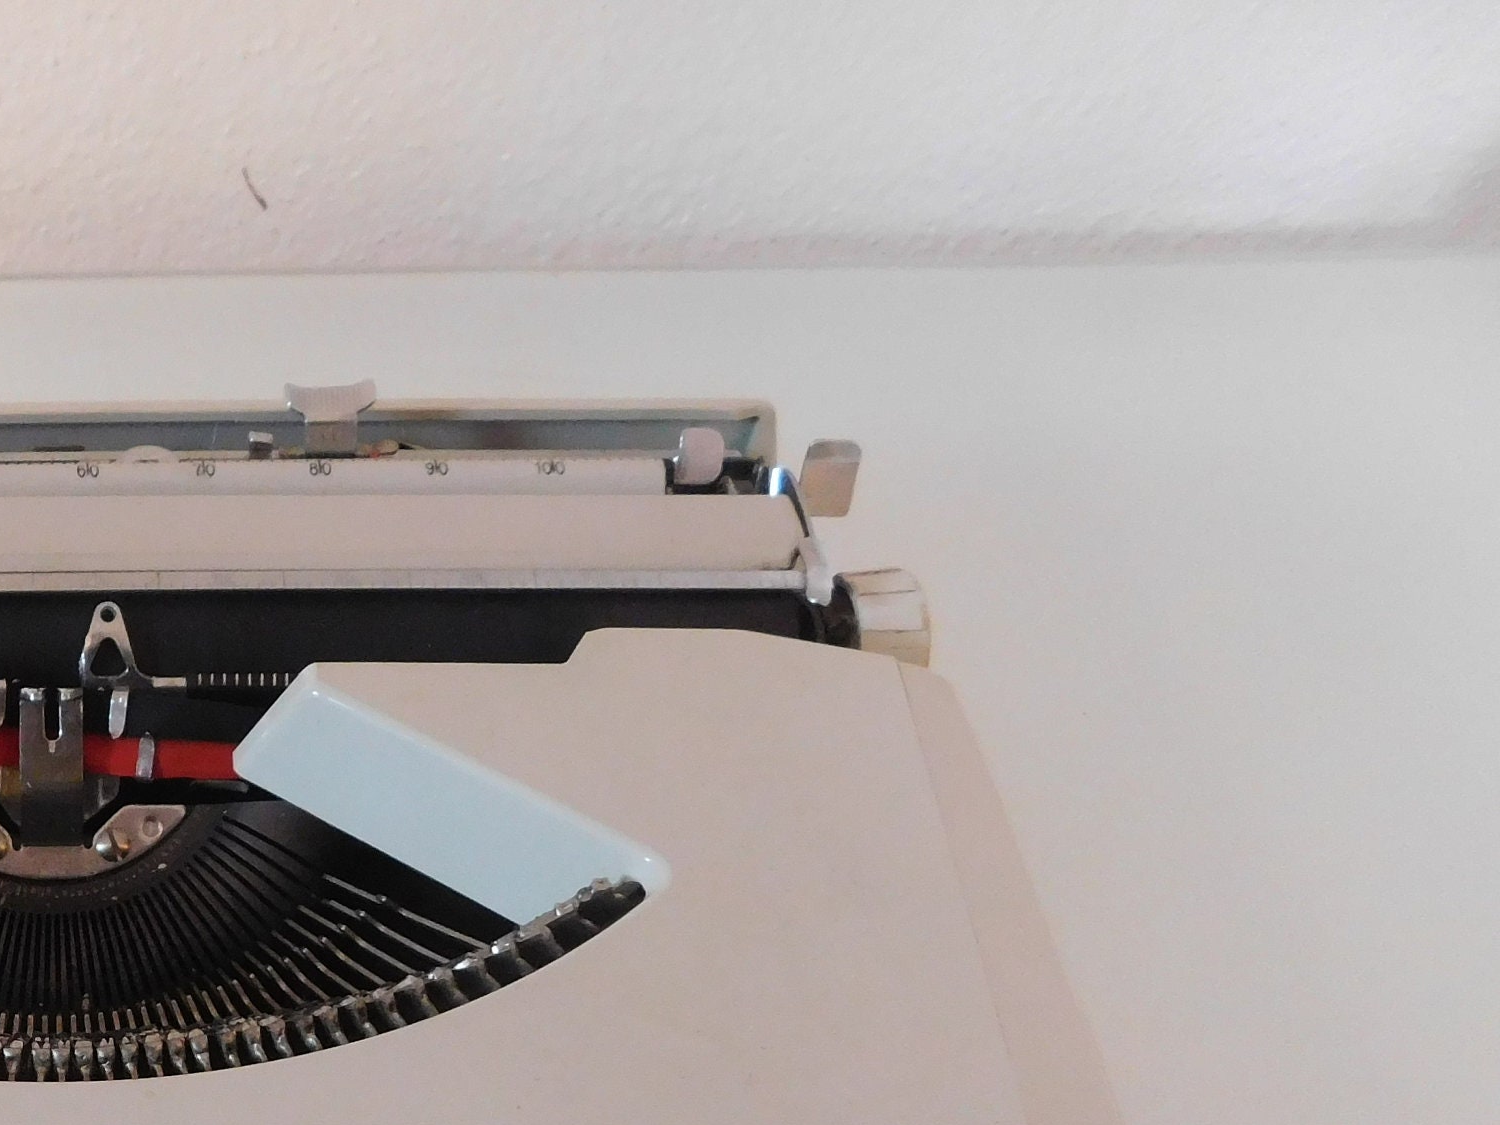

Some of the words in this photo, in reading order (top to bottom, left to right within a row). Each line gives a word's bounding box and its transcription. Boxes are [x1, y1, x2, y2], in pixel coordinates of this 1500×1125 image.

[76, 464, 100, 478] 60
[308, 462, 332, 476] 80
[424, 461, 449, 476] 90
